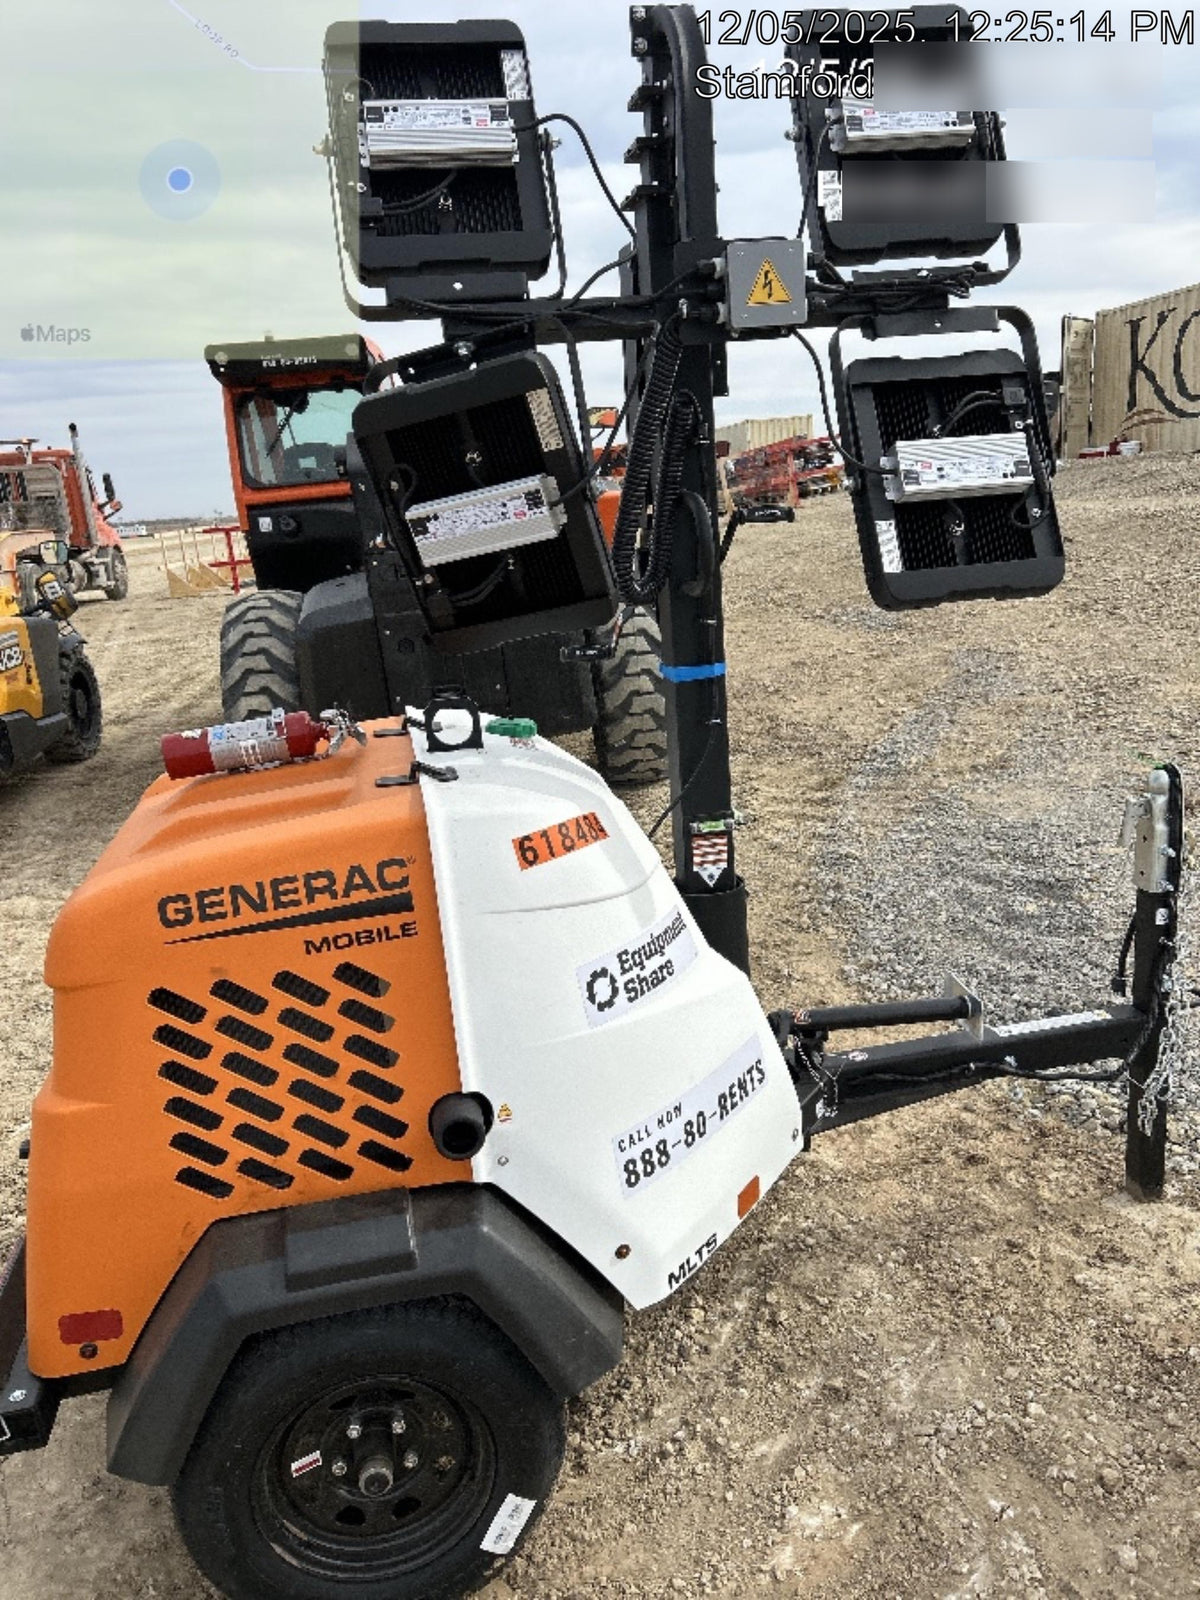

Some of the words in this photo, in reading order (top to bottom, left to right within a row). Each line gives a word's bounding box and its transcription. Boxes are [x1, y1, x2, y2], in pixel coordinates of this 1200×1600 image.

[157, 857, 410, 929] GENERAC
[303, 920, 418, 955] MOBILE
[616, 912, 688, 976] Equipment
[623, 959, 675, 1003] Share
[618, 1125, 651, 1152] CALL
[657, 1102, 682, 1130] NOW
[623, 1059, 766, 1188] 888-80-RENTS
[667, 1233, 718, 1290] MLTS
